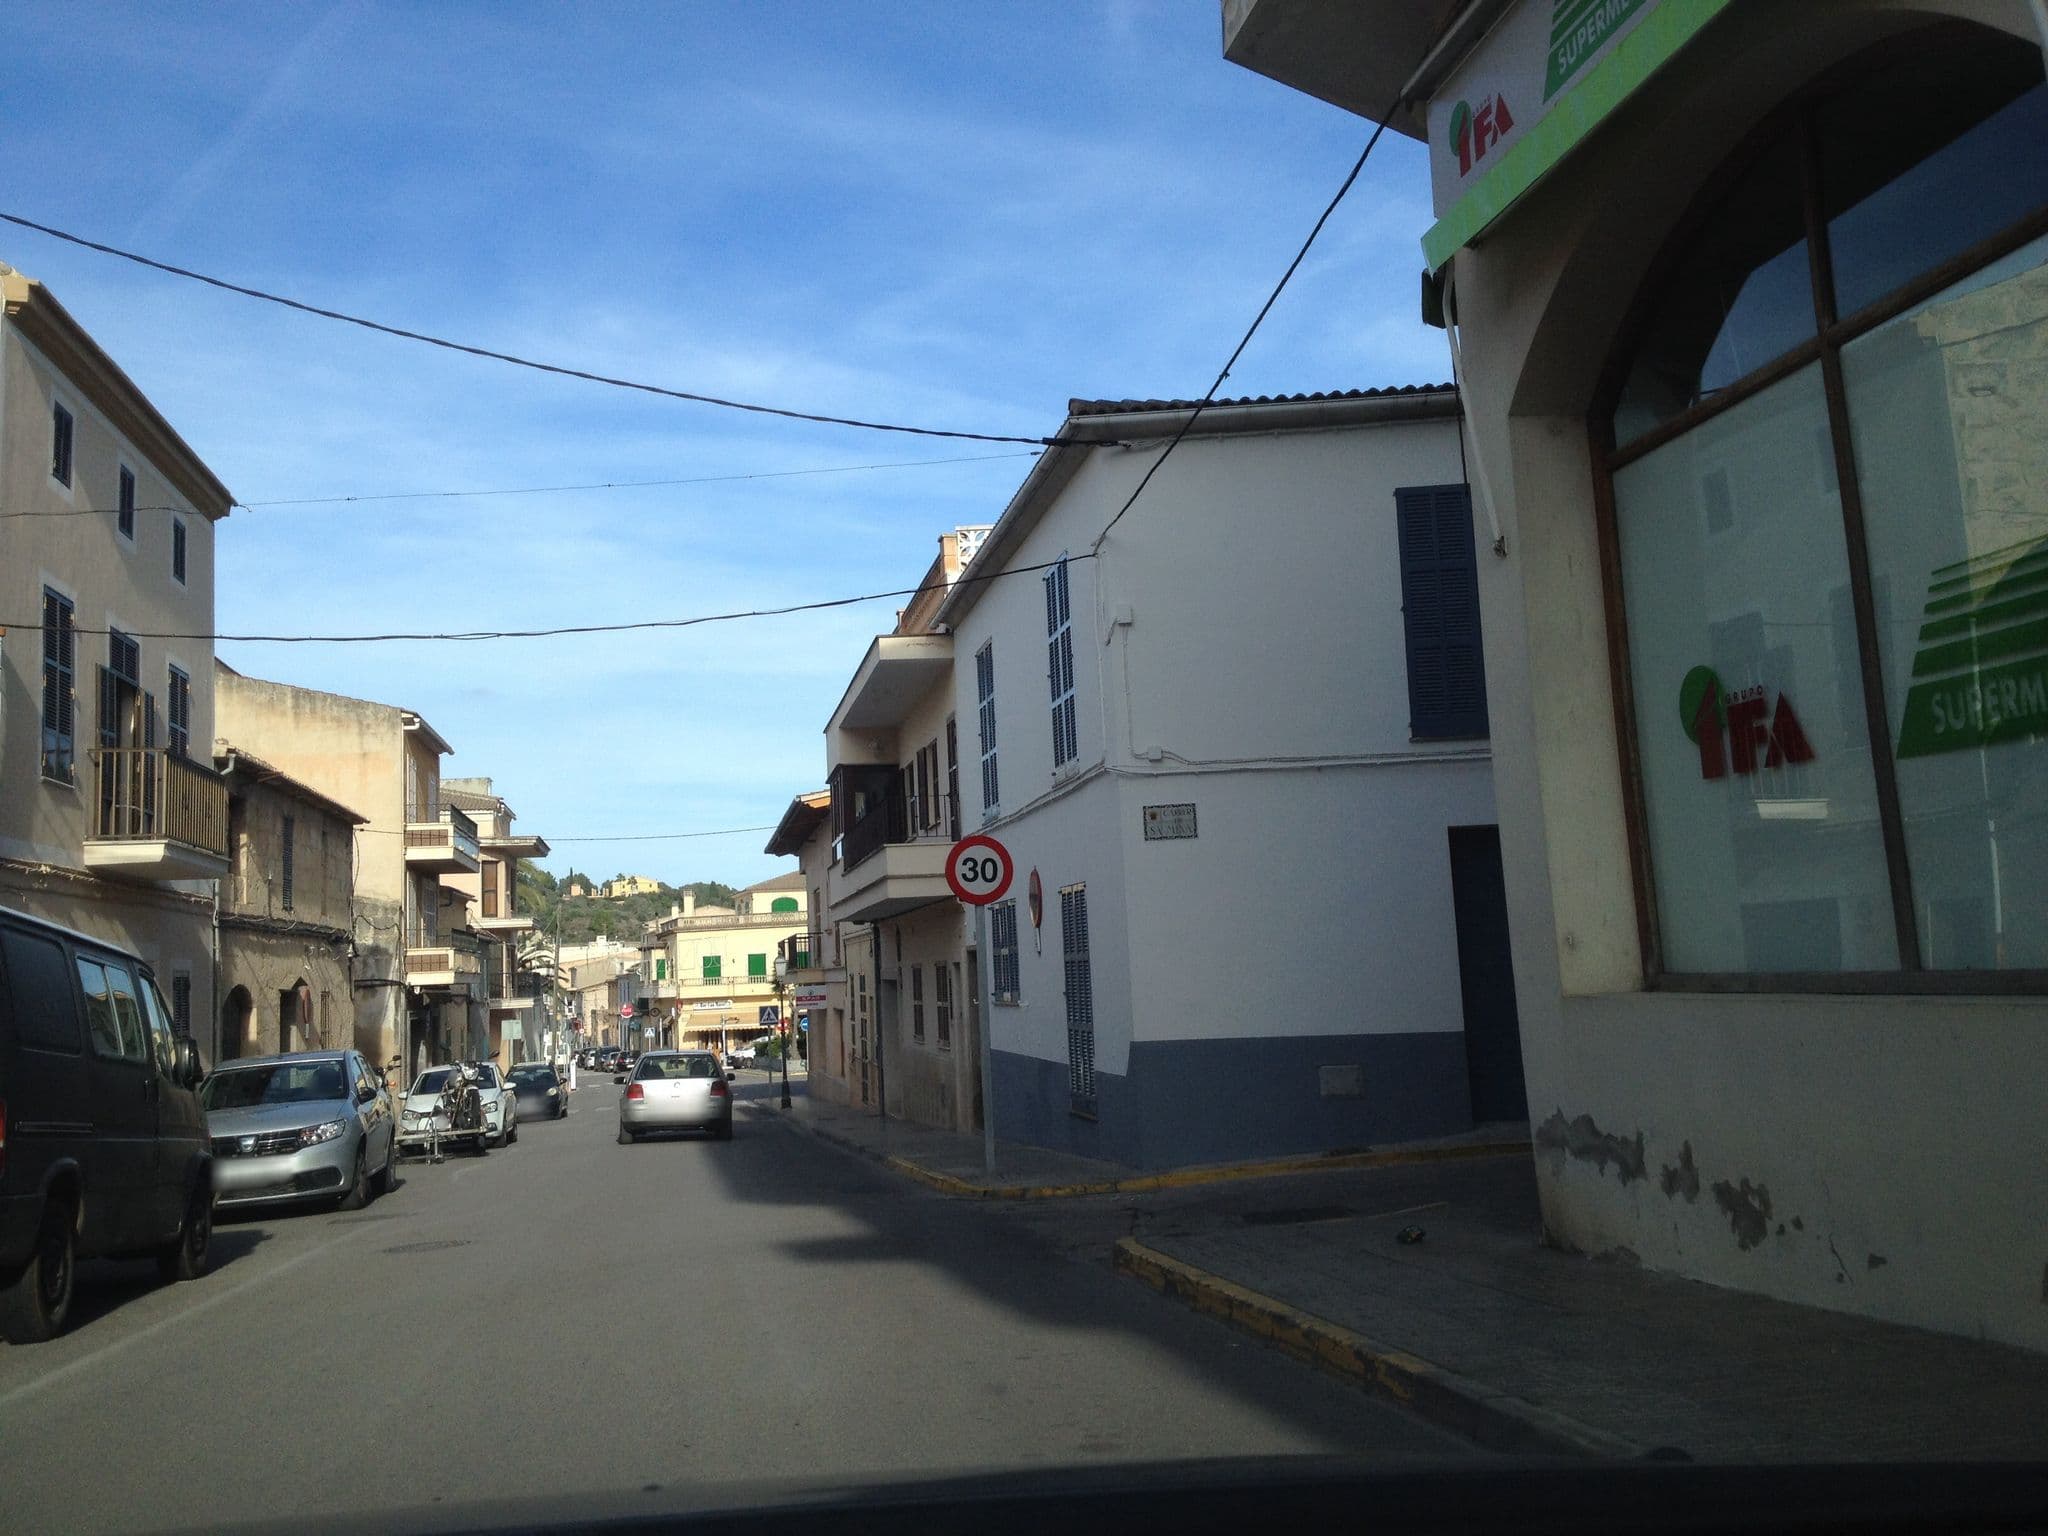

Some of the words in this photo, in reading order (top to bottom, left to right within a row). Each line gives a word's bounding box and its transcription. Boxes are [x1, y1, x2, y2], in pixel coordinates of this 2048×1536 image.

[1453, 93, 1514, 178] IFA
[1725, 685, 1764, 705] GRUPO
[1696, 679, 1816, 779] IFA
[961, 857, 998, 883] 30
